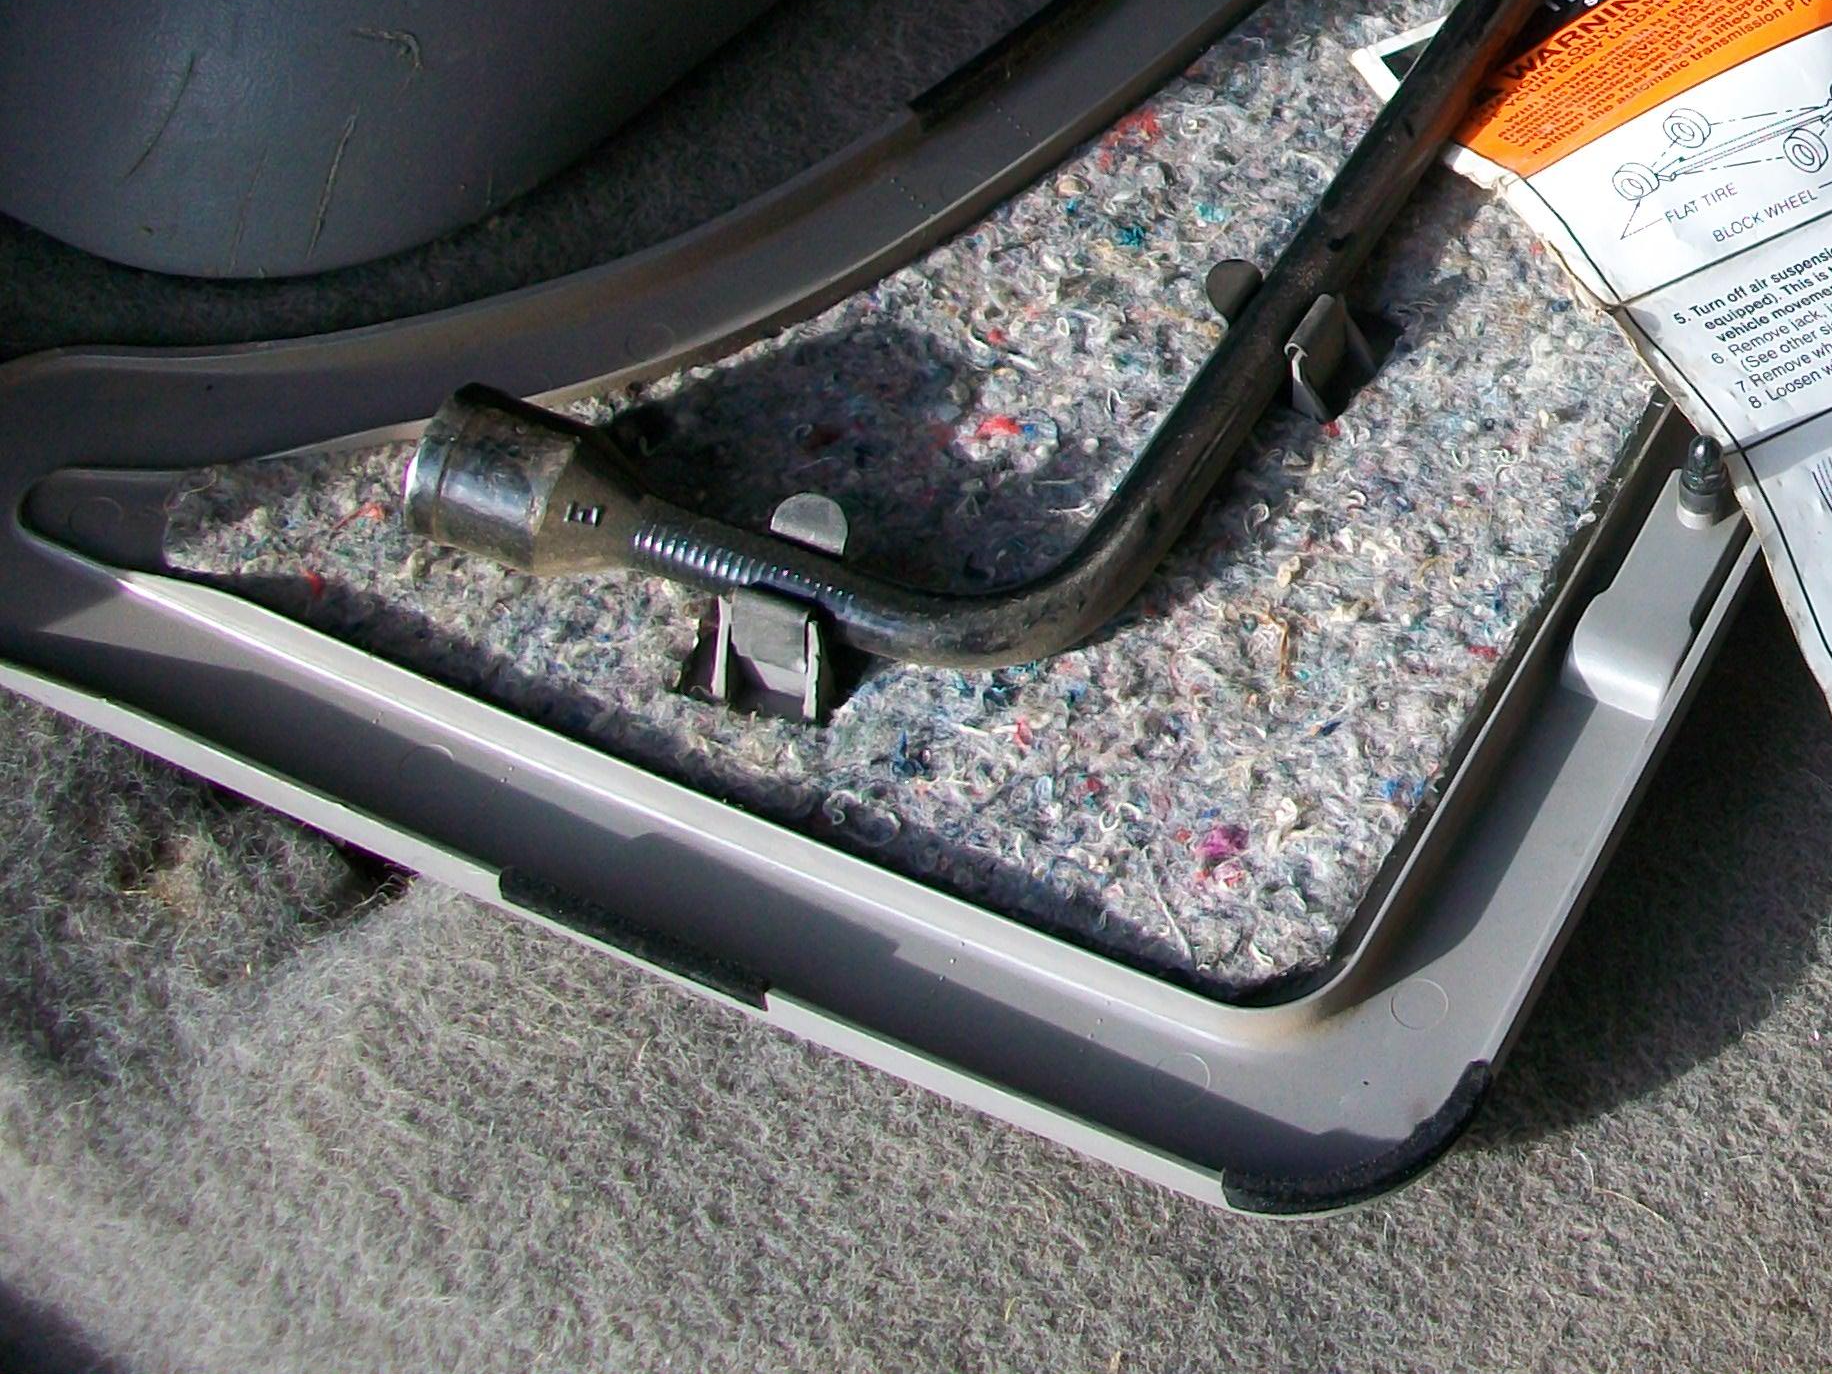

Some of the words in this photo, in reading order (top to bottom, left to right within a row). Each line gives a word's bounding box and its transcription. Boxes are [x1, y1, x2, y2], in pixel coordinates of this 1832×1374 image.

[1690, 5, 1785, 63] transmission
[1663, 199, 1699, 224] FLAT
[1700, 181, 1738, 206] TIRE
[1711, 210, 1765, 243] BLOCK
[1762, 188, 1818, 219] WHEEL
[1672, 311, 1691, 325] 5.
[1690, 297, 1726, 317] Turn
[1726, 284, 1748, 303] off
[1748, 277, 1768, 293] air
[1745, 353, 1812, 388] Remove
[1763, 369, 1822, 401] Loosen
